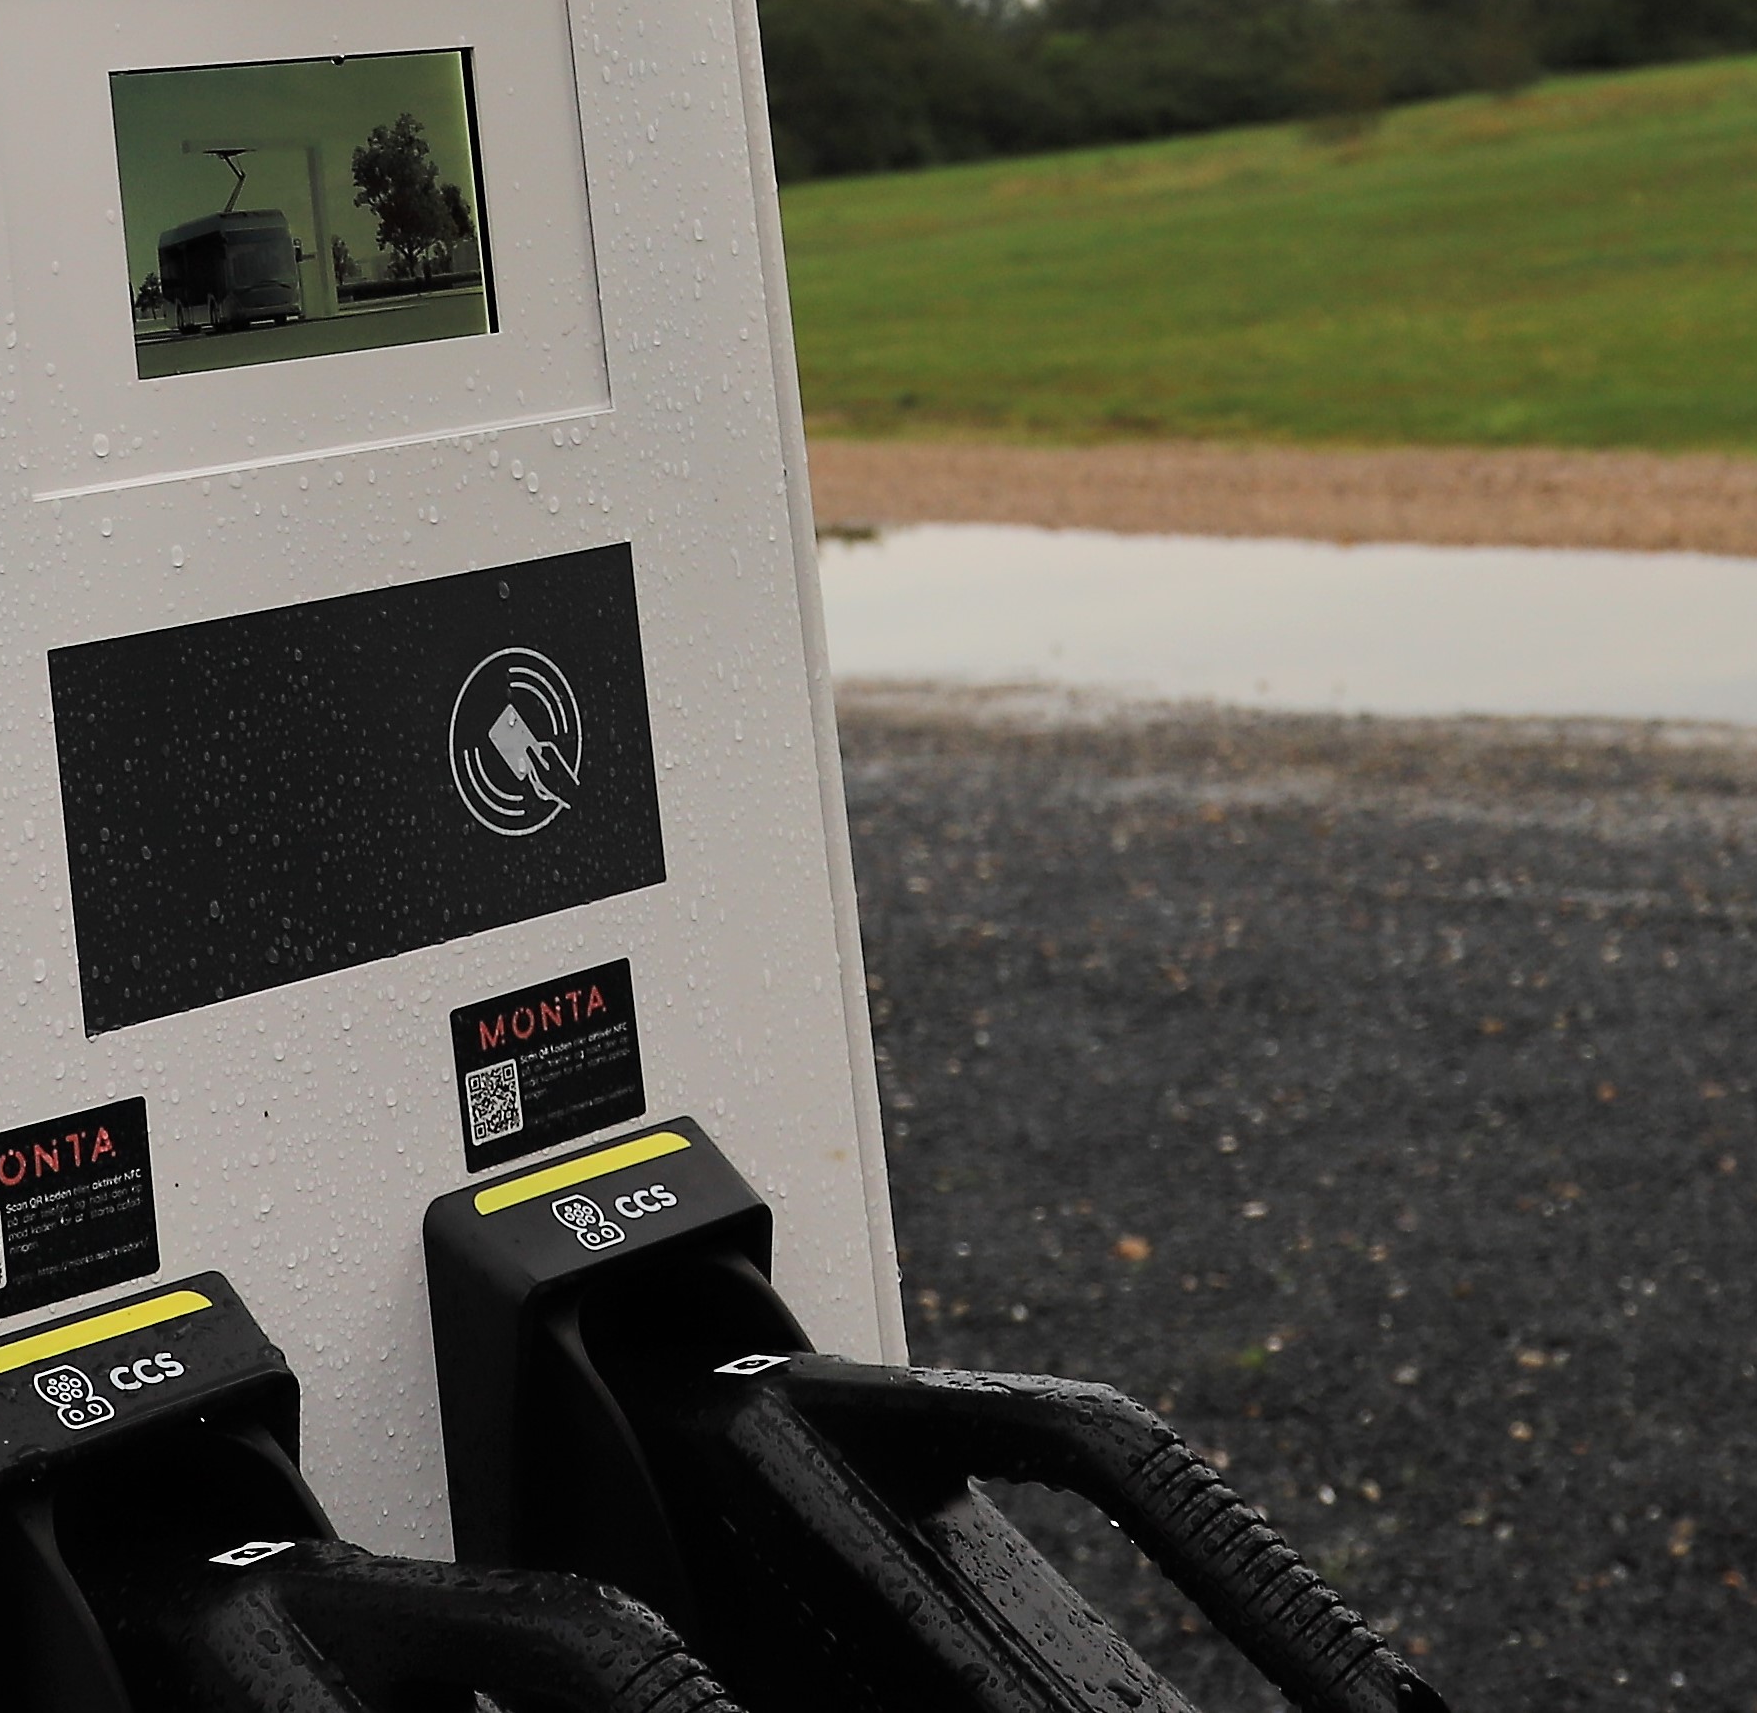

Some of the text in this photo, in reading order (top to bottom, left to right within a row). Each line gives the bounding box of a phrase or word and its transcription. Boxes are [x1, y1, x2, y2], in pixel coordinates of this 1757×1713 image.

[479, 985, 608, 1051] MONTA
[6, 1201, 28, 1214] Scan
[29, 1195, 43, 1209] QR
[614, 1184, 678, 1219] CCS
[109, 1352, 185, 1390] CCS
